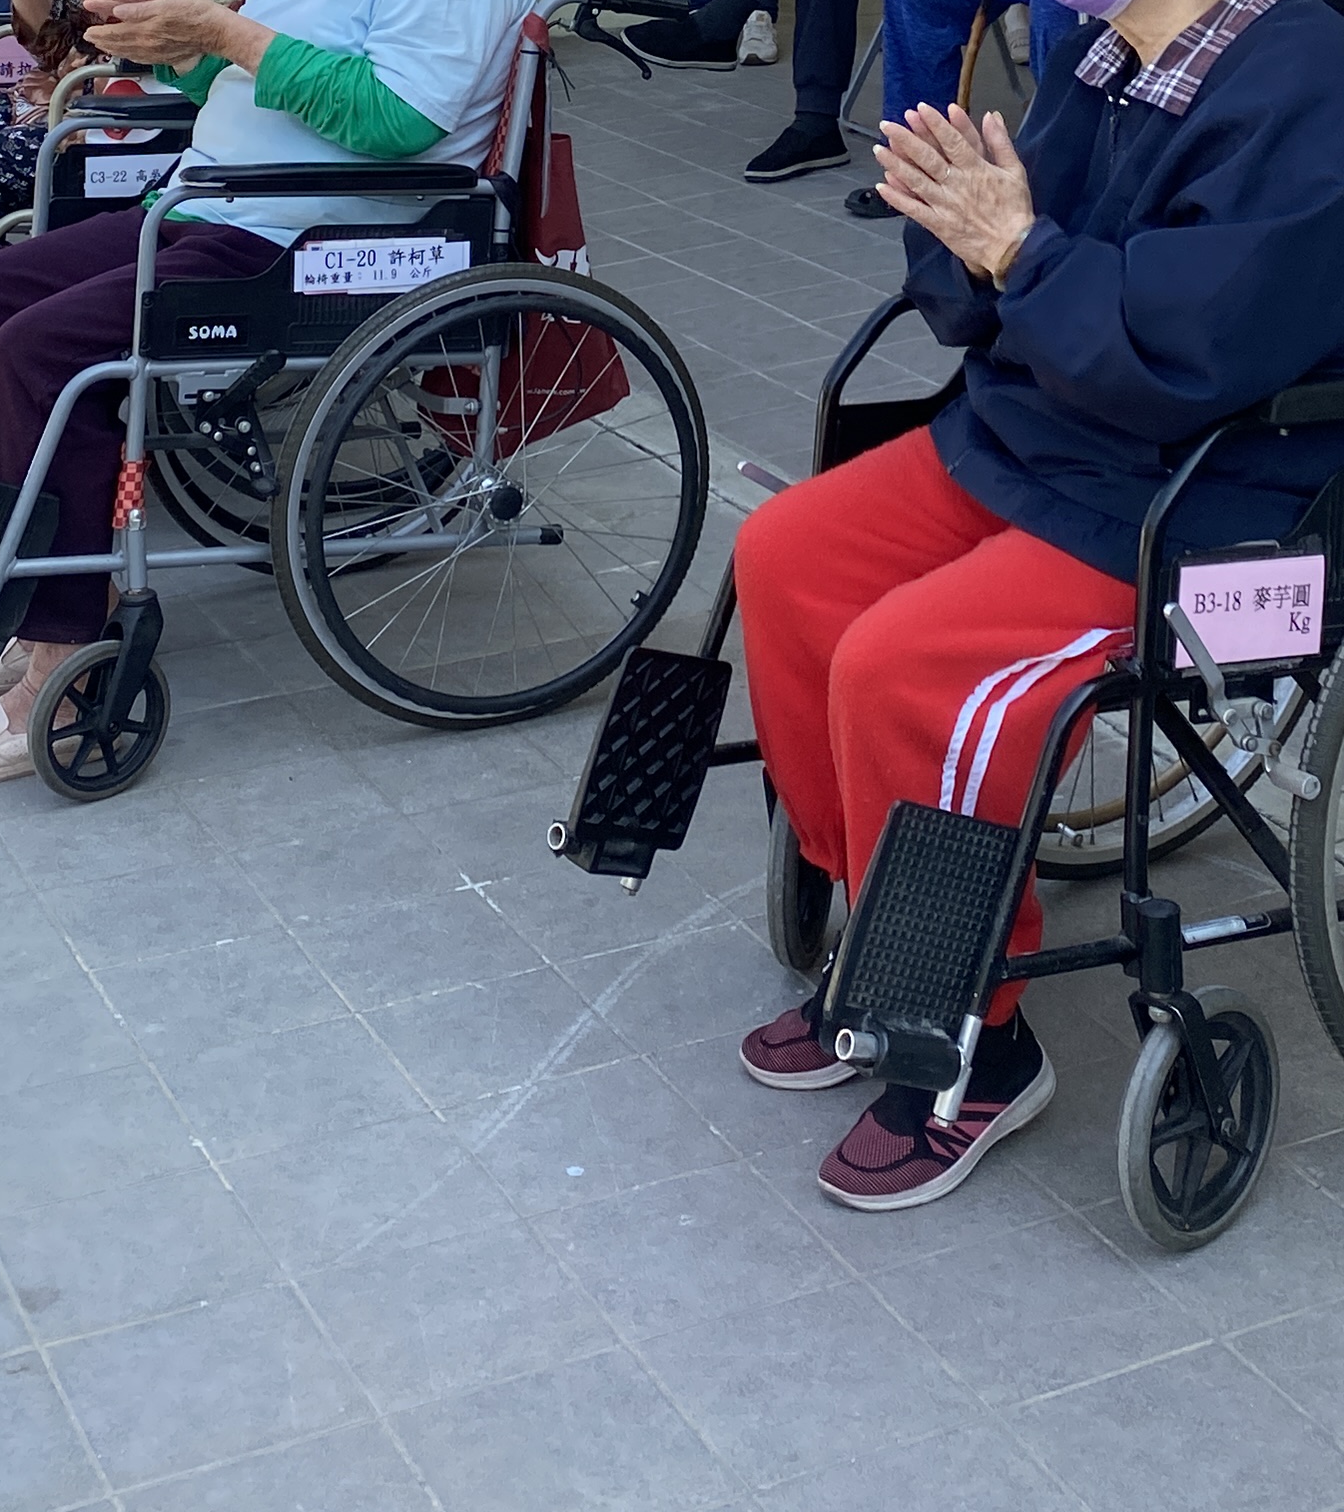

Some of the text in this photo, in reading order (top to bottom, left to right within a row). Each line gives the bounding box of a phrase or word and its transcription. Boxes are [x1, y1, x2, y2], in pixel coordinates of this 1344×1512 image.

[90, 170, 128, 184] C3-22
[325, 244, 445, 269] C1-20 許柯草
[373, 268, 397, 281] 11.9
[409, 266, 432, 279] 公斤
[188, 324, 238, 340] SOMA
[1193, 590, 1242, 614] B3-18
[1288, 611, 1312, 634] Kg
